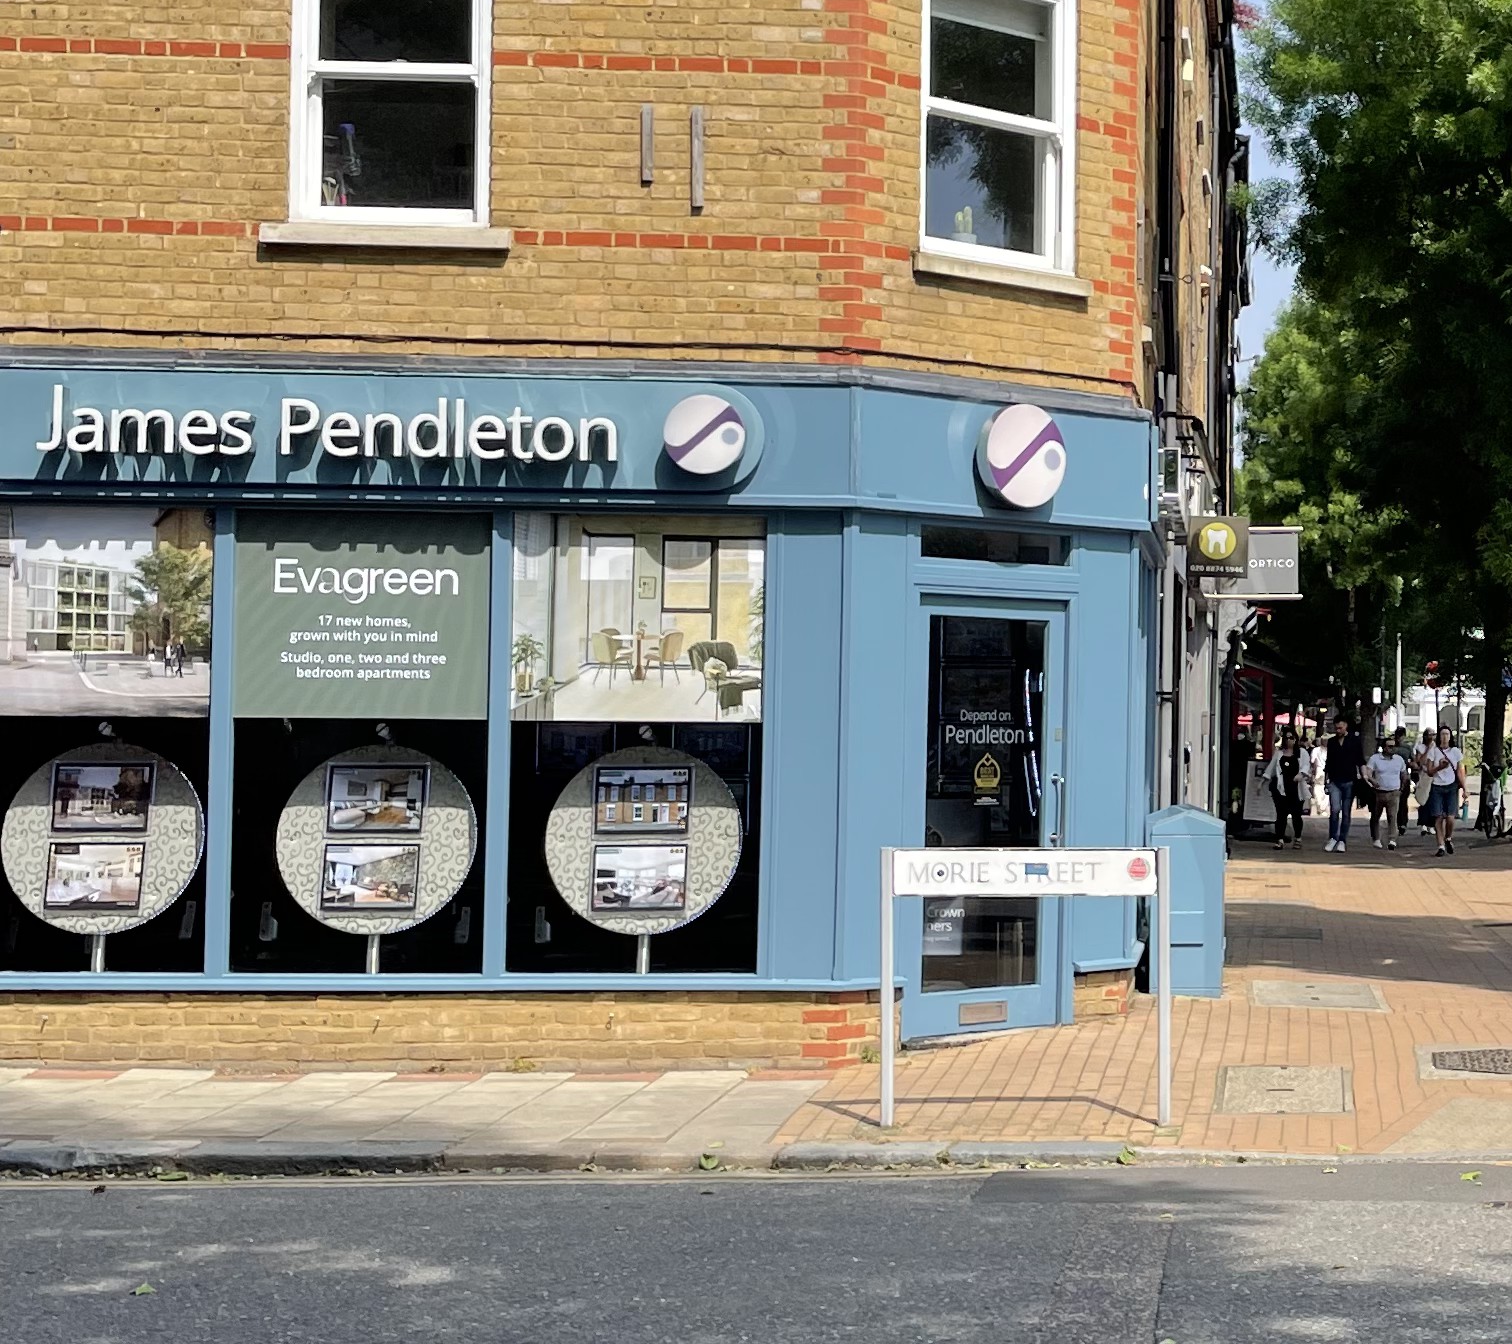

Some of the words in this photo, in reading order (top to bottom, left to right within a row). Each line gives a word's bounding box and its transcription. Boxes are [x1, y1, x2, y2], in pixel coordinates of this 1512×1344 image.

[35, 384, 254, 456] James
[280, 397, 618, 463] Pendleton
[1248, 558, 1295, 568] ORTICO
[273, 557, 459, 604] Evagreen
[318, 615, 333, 626] 17
[335, 617, 363, 627] new
[365, 615, 412, 629] homes,
[289, 632, 330, 644] grown
[332, 630, 361, 642] with
[363, 633, 388, 645] you
[390, 631, 402, 642] in
[405, 630, 438, 643] mind
[280, 651, 324, 665] Studio,
[327, 654, 355, 665] one,
[358, 653, 382, 664] two
[385, 652, 409, 664] and
[412, 652, 447, 665] three
[296, 666, 354, 679] bedroom
[357, 667, 431, 682] apartments
[960, 709, 997, 724] Depend
[998, 711, 1012, 721] on
[945, 725, 1025, 744] Pendleton
[907, 861, 990, 885] MORIE
[927, 906, 966, 918] Crown
[926, 922, 953, 932] ners
